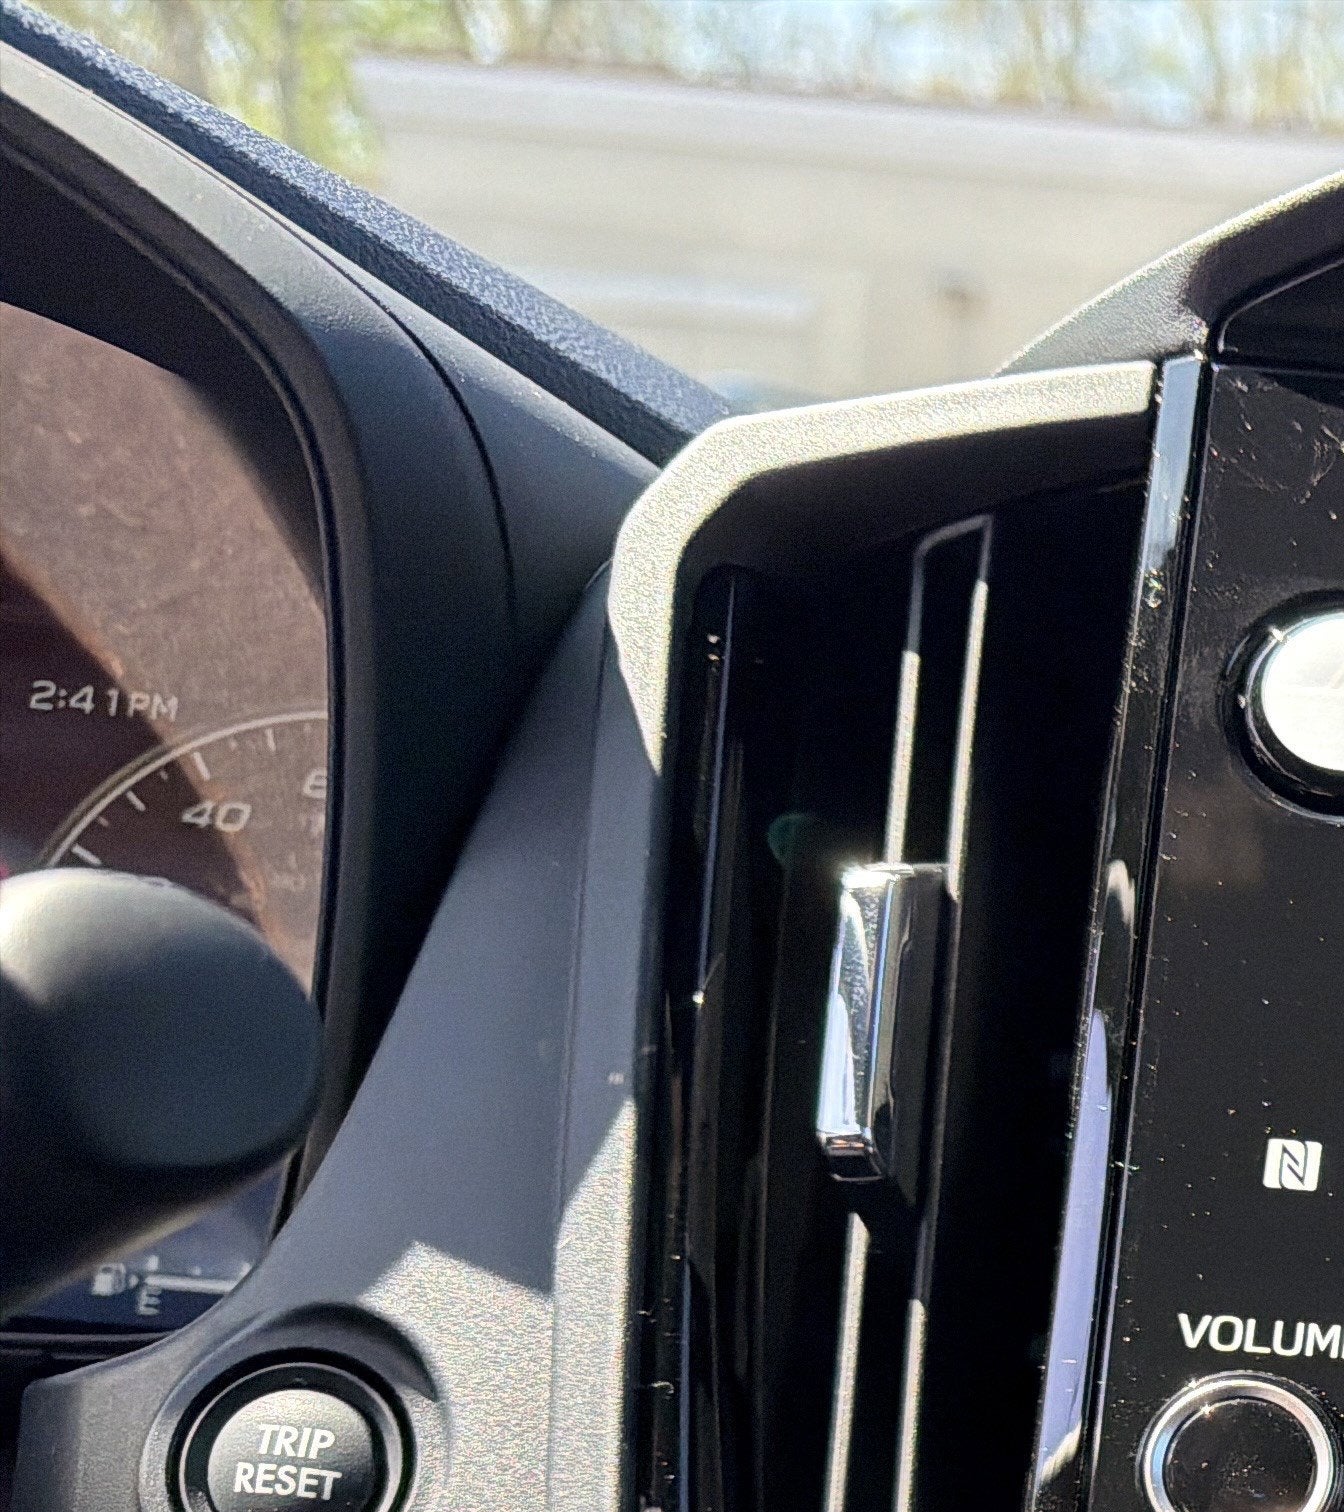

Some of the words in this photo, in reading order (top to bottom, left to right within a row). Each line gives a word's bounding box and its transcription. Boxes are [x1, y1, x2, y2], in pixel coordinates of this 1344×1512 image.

[181, 801, 251, 833] 40
[257, 1422, 336, 1460] TRIP
[232, 1461, 343, 1501] RESET
